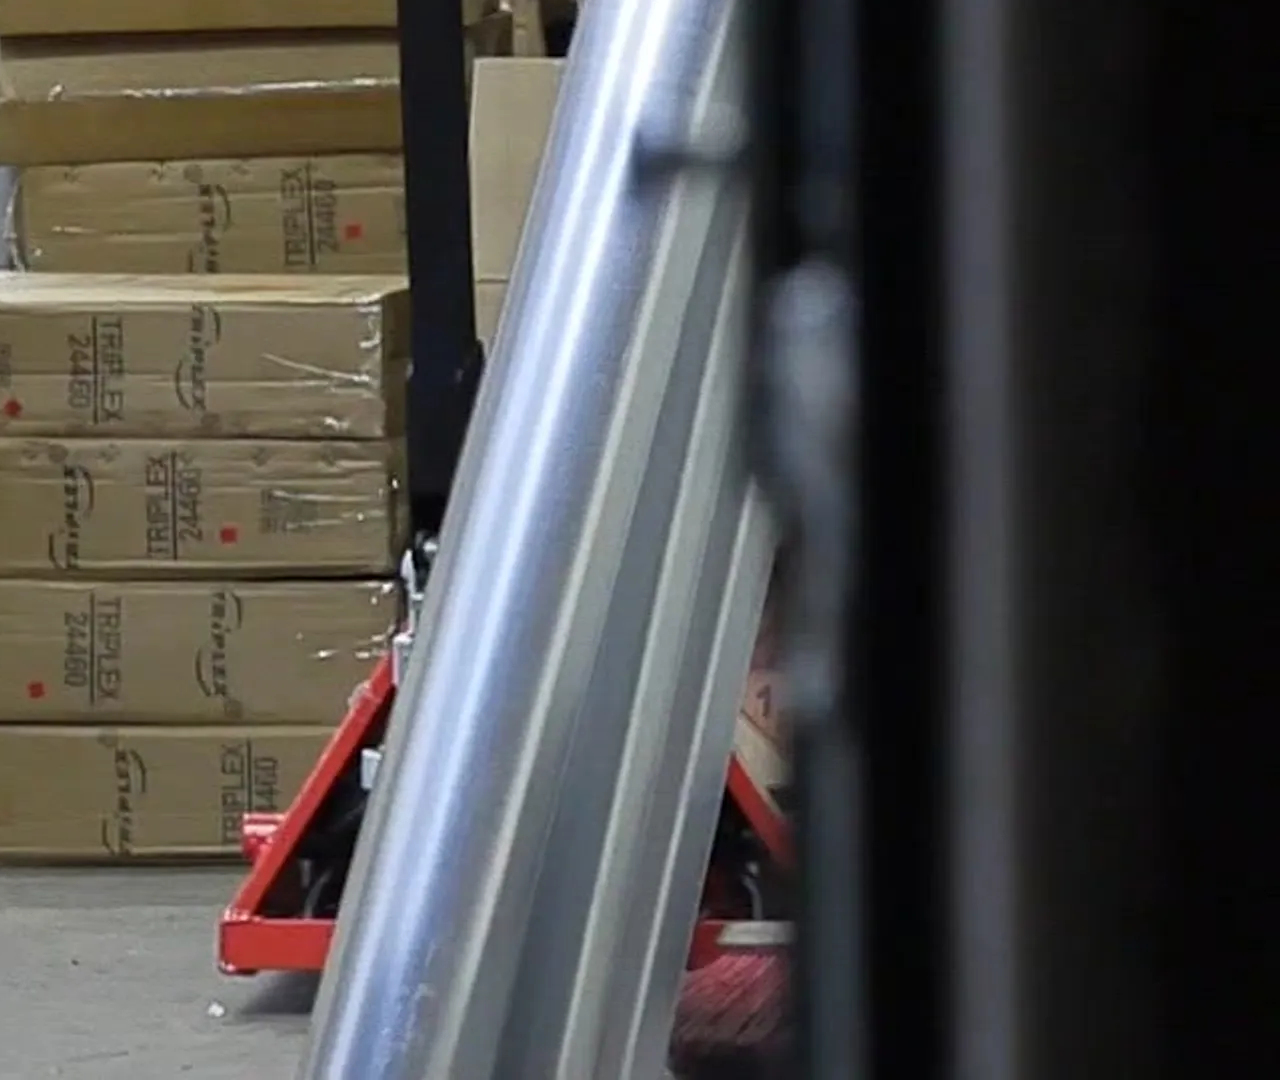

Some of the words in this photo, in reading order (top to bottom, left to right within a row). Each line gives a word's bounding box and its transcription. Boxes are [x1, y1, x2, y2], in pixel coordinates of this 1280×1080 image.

[281, 169, 307, 266] TRIPLEX
[68, 333, 91, 409] 24460
[100, 316, 124, 421] TRIPLEX
[146, 456, 170, 558] TRIPLEX
[179, 467, 203, 541] 24460
[64, 611, 88, 688] 24460
[97, 597, 121, 700] TRIPLEX
[222, 744, 244, 845] TRIPLEX
